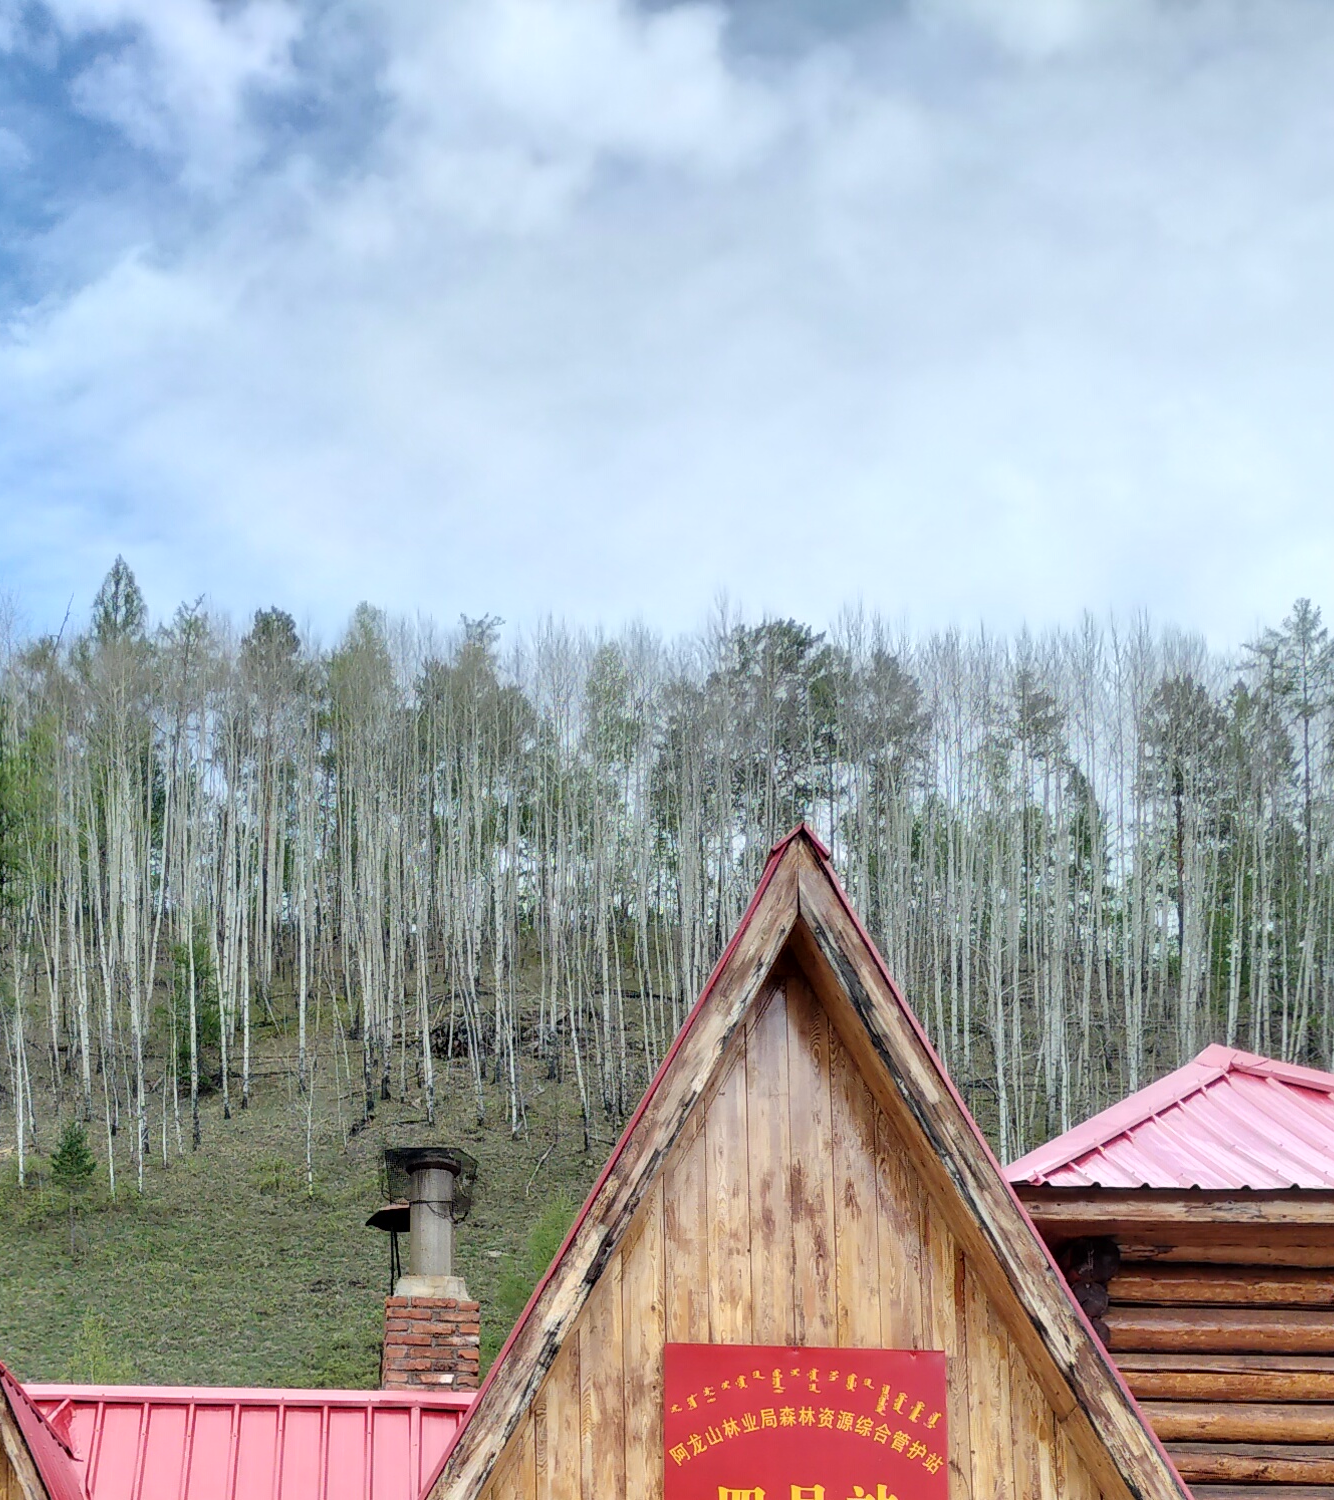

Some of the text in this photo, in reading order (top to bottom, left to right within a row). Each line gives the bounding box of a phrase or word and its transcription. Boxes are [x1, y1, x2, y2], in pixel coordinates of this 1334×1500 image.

[668, 1405, 944, 1475] 阿龙山林业局森林资源综合管护站
